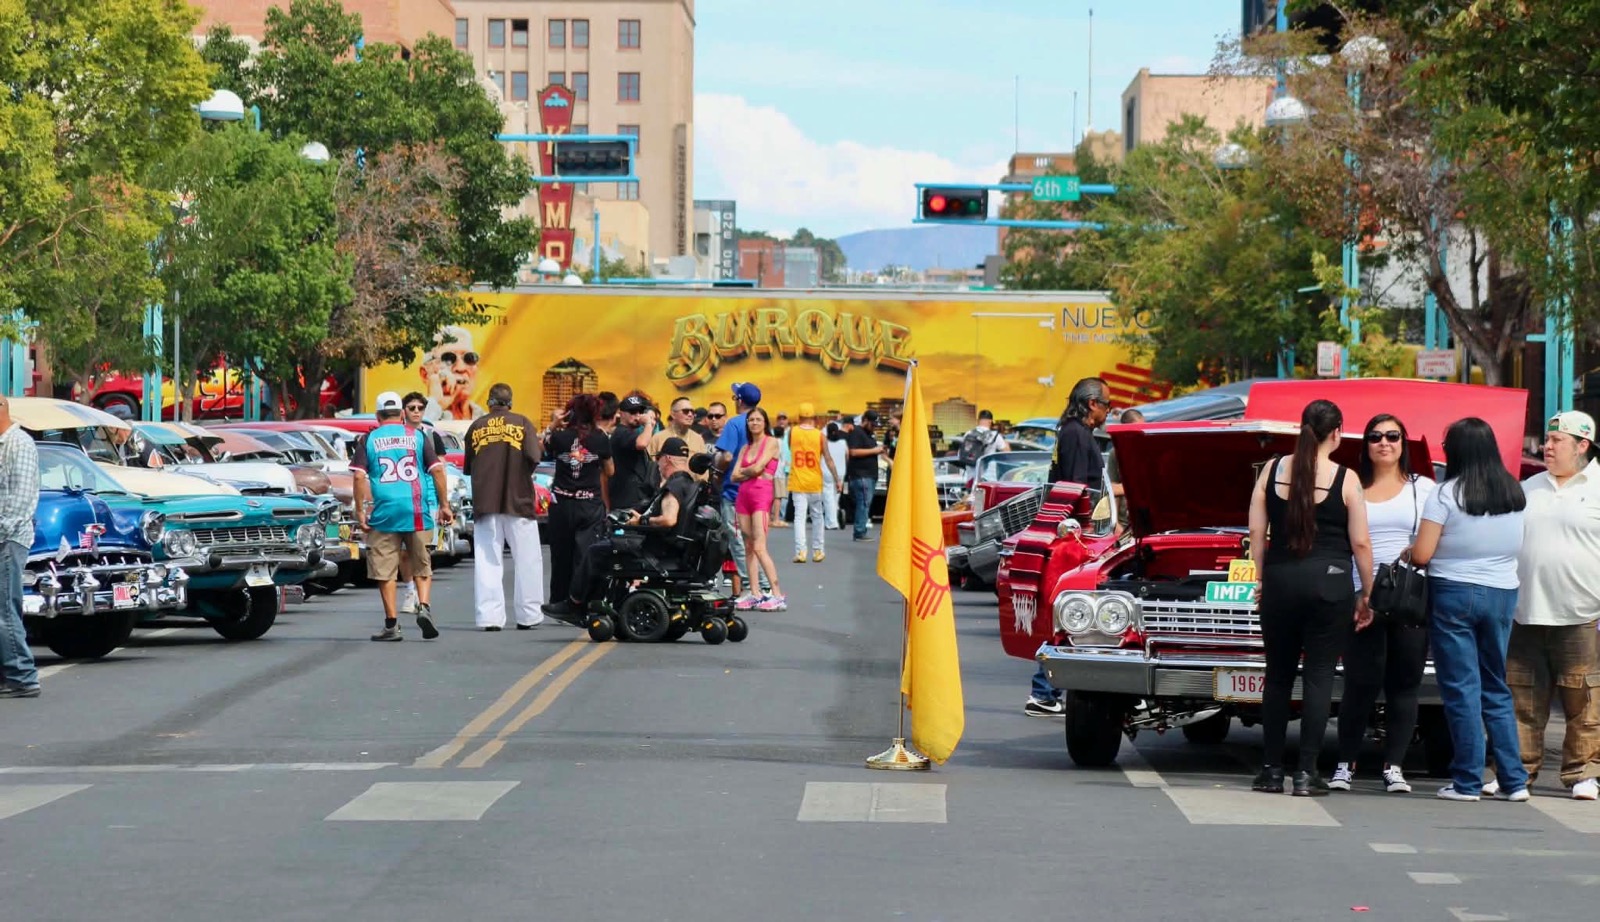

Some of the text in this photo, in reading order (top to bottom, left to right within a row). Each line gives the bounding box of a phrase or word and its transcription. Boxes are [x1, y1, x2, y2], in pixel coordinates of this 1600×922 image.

[546, 125, 566, 262] KMO
[1034, 180, 1078, 197] 6th St
[722, 212, 733, 240] ONE
[666, 307, 912, 389] BURQUE
[378, 456, 418, 482] 26
[794, 450, 816, 468] 66
[1231, 675, 1266, 692] 1962
